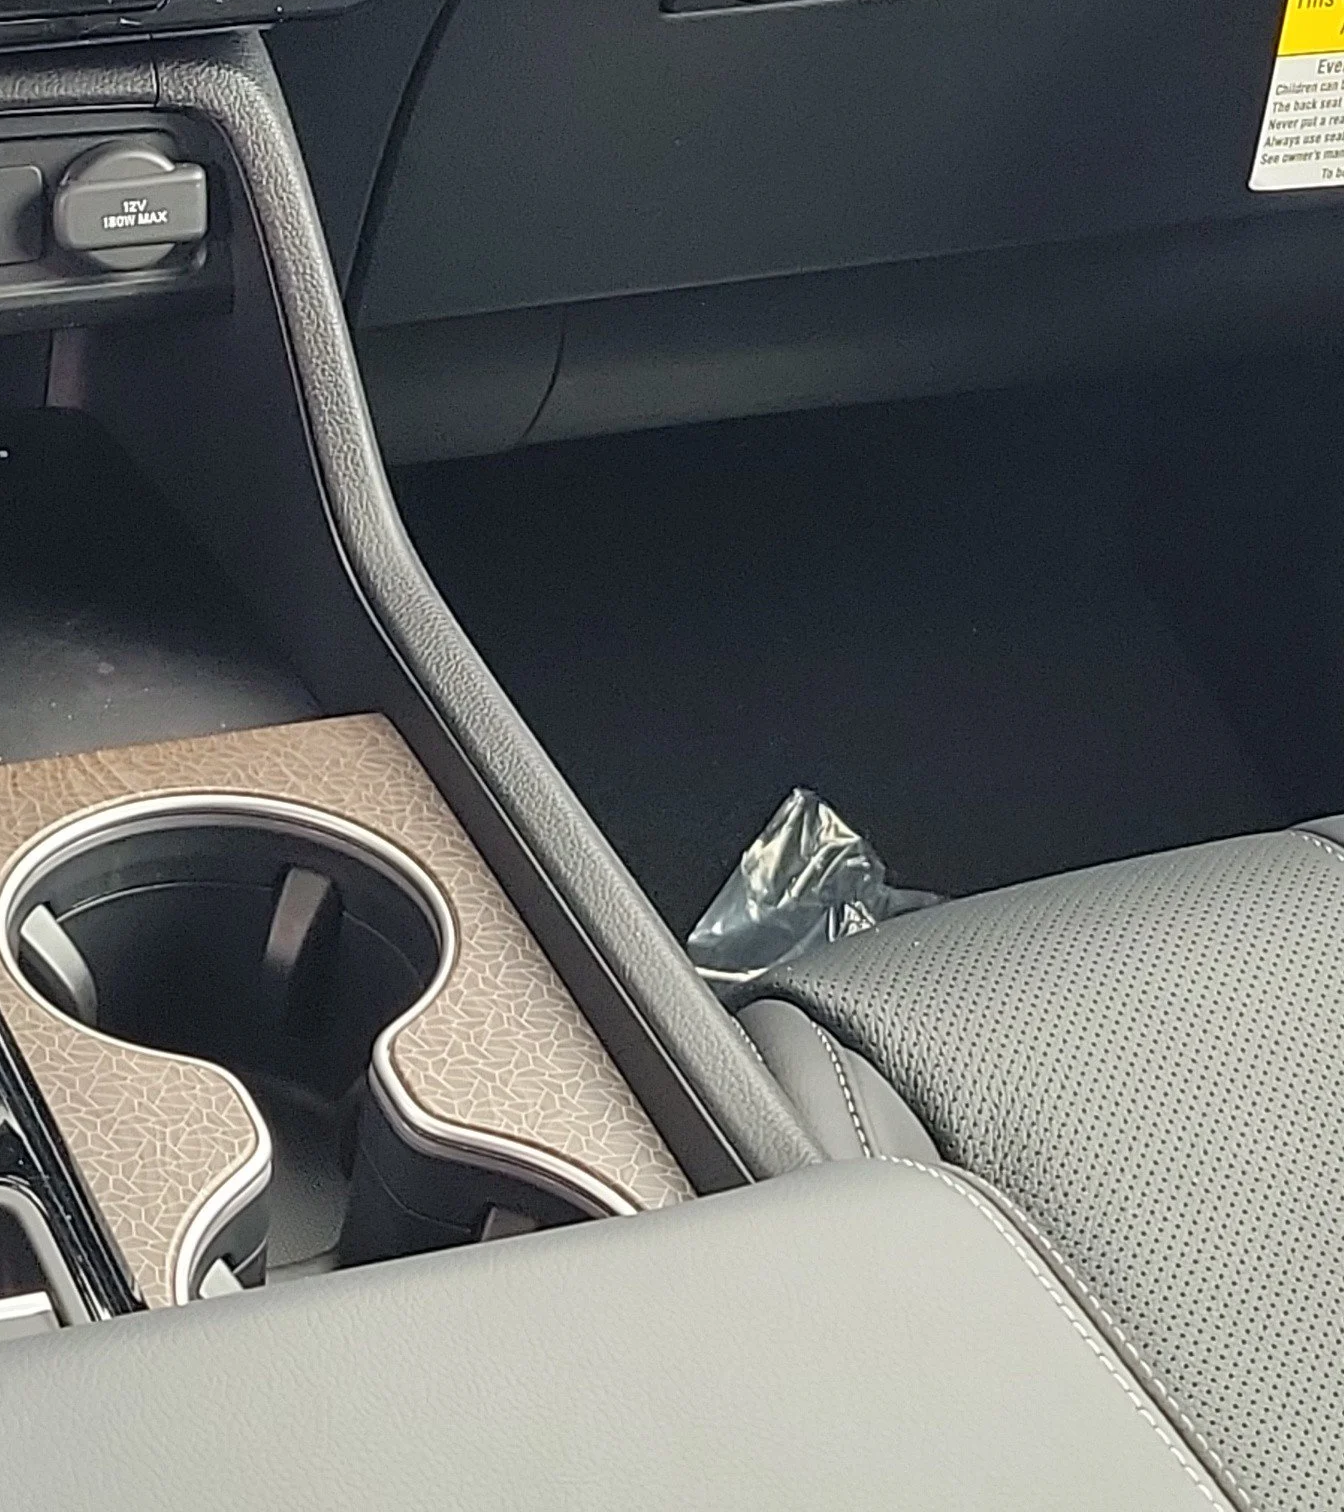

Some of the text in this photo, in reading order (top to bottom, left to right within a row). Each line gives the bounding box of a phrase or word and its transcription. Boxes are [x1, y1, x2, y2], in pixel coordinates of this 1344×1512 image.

[1275, 82, 1317, 96] Children
[1320, 82, 1338, 92] can
[1272, 101, 1291, 114] The
[1293, 98, 1317, 111] back
[1320, 97, 1343, 109] seat
[1268, 118, 1298, 131] Never
[1301, 117, 1317, 131] put
[1263, 135, 1300, 149] Always
[1303, 135, 1322, 145] use
[1260, 153, 1279, 166] See
[1282, 149, 1321, 163] owner's
[1321, 167, 1333, 180] To
[122, 200, 147, 213] 12V
[103, 211, 168, 229] 180W MAX
